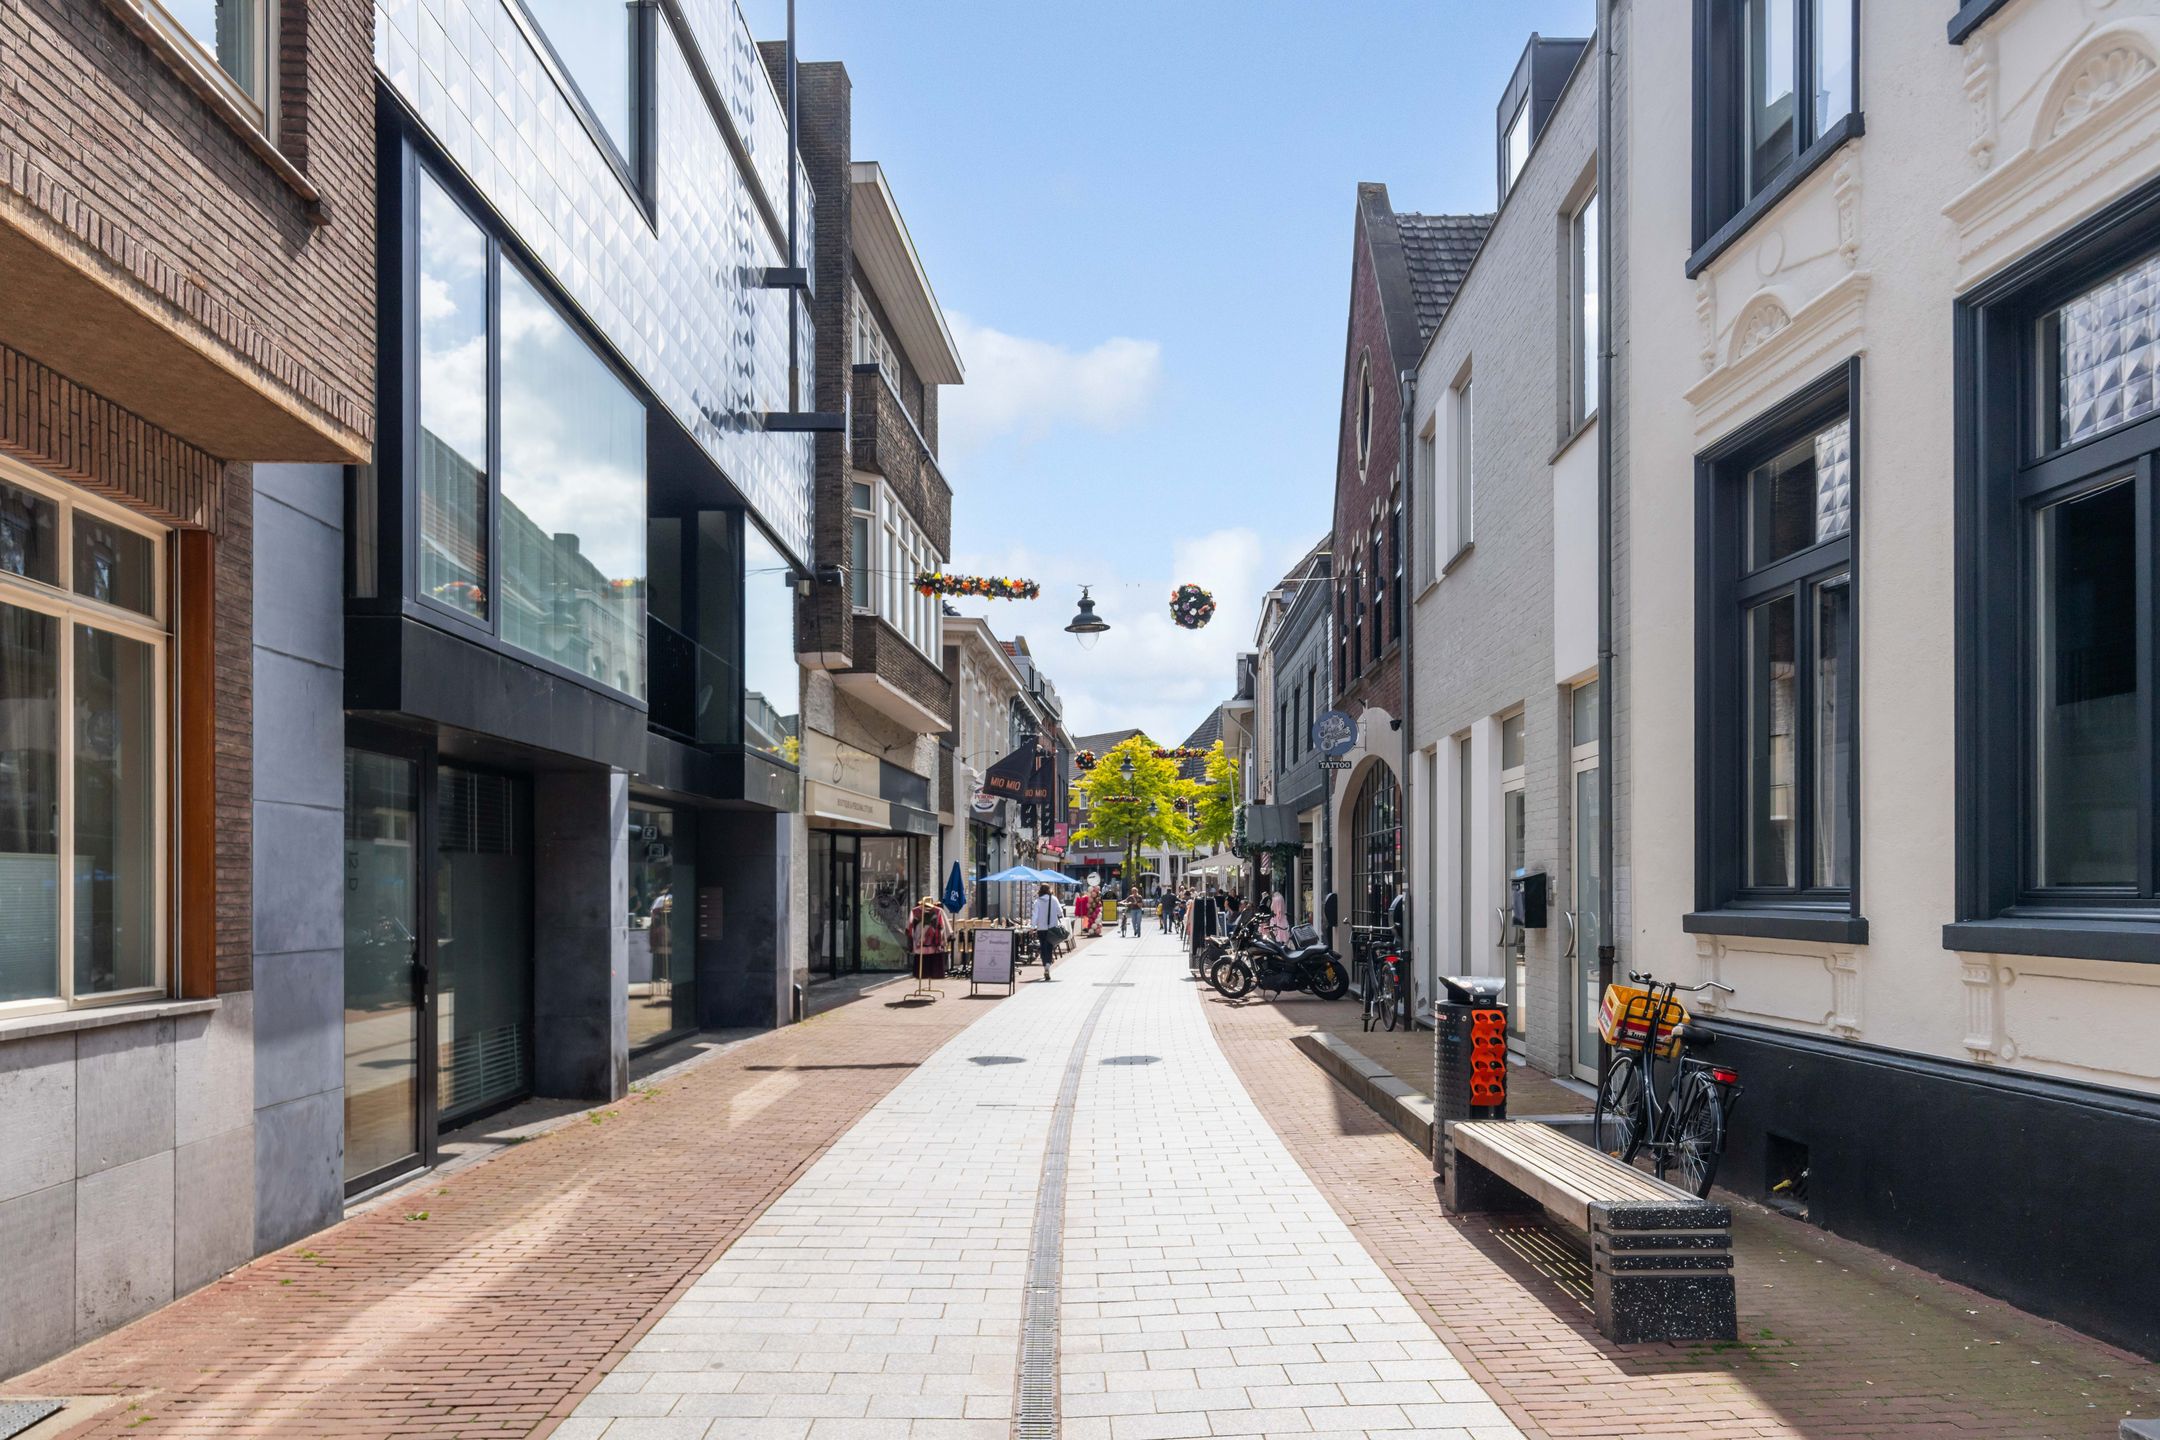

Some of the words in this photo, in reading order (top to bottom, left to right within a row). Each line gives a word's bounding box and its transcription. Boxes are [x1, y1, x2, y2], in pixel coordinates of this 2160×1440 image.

[990, 776, 1005, 788] MIO
[1006, 780, 1021, 791] MIO
[1035, 789, 1047, 798] MIO
